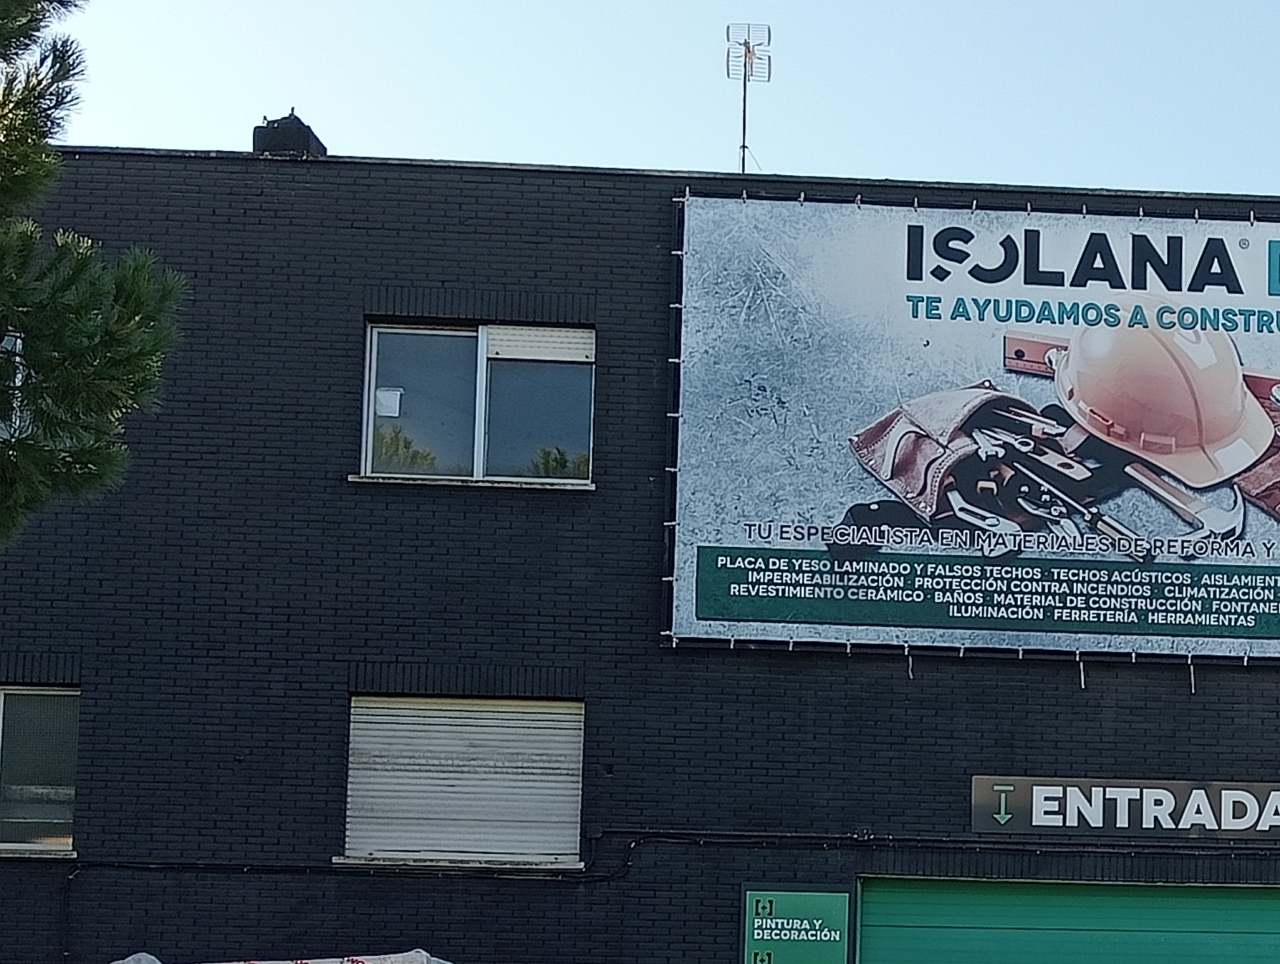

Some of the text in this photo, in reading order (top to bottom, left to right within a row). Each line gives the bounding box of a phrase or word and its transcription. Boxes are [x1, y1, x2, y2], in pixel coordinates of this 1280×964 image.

[907, 225, 1244, 294] ISOLANA
[907, 295, 941, 319] TE
[950, 298, 1121, 327] AYUDAMOS
[1128, 305, 1148, 328] A
[779, 525, 933, 546] ESPECIALISTA
[939, 530, 969, 547] EN
[975, 531, 1111, 552] MATERIALES
[1116, 538, 1146, 554] DE
[1152, 539, 1255, 558] REFORMA
[1262, 543, 1276, 557] Y
[717, 557, 765, 569] PLACA
[769, 559, 789, 570] DE
[791, 559, 831, 571] YESO
[834, 561, 911, 574] LAMINADO
[914, 563, 924, 574] Y
[927, 564, 981, 577] FALSOS
[984, 566, 1041, 579] TECHOS
[1051, 568, 1108, 581] TECHOS
[1111, 569, 1191, 584] ACÚSTICOS
[730, 584, 845, 599] REVESTIMIENTO
[847, 586, 925, 602] CERÁMICO
[935, 590, 983, 604] BAÑOS
[994, 594, 1063, 607] MATERIAL
[1066, 596, 1086, 607] DE
[1089, 597, 1201, 611] CONSTRUCCIÓN
[749, 571, 904, 587] IMPERMEABILIZACIÓN
[914, 577, 1007, 592] PROTECCIÓN
[1010, 581, 1070, 594] CONTRA
[1073, 583, 1151, 596] INCENDIOS
[1164, 586, 1274, 600] CLIMATIZACIÓN
[949, 605, 1255, 626] ILUMINACIÓN FERRETERÍA HERRAMIENTAS
[754, 919, 822, 929] PINTURA Y
[754, 929, 840, 940] DECORACIÓN
